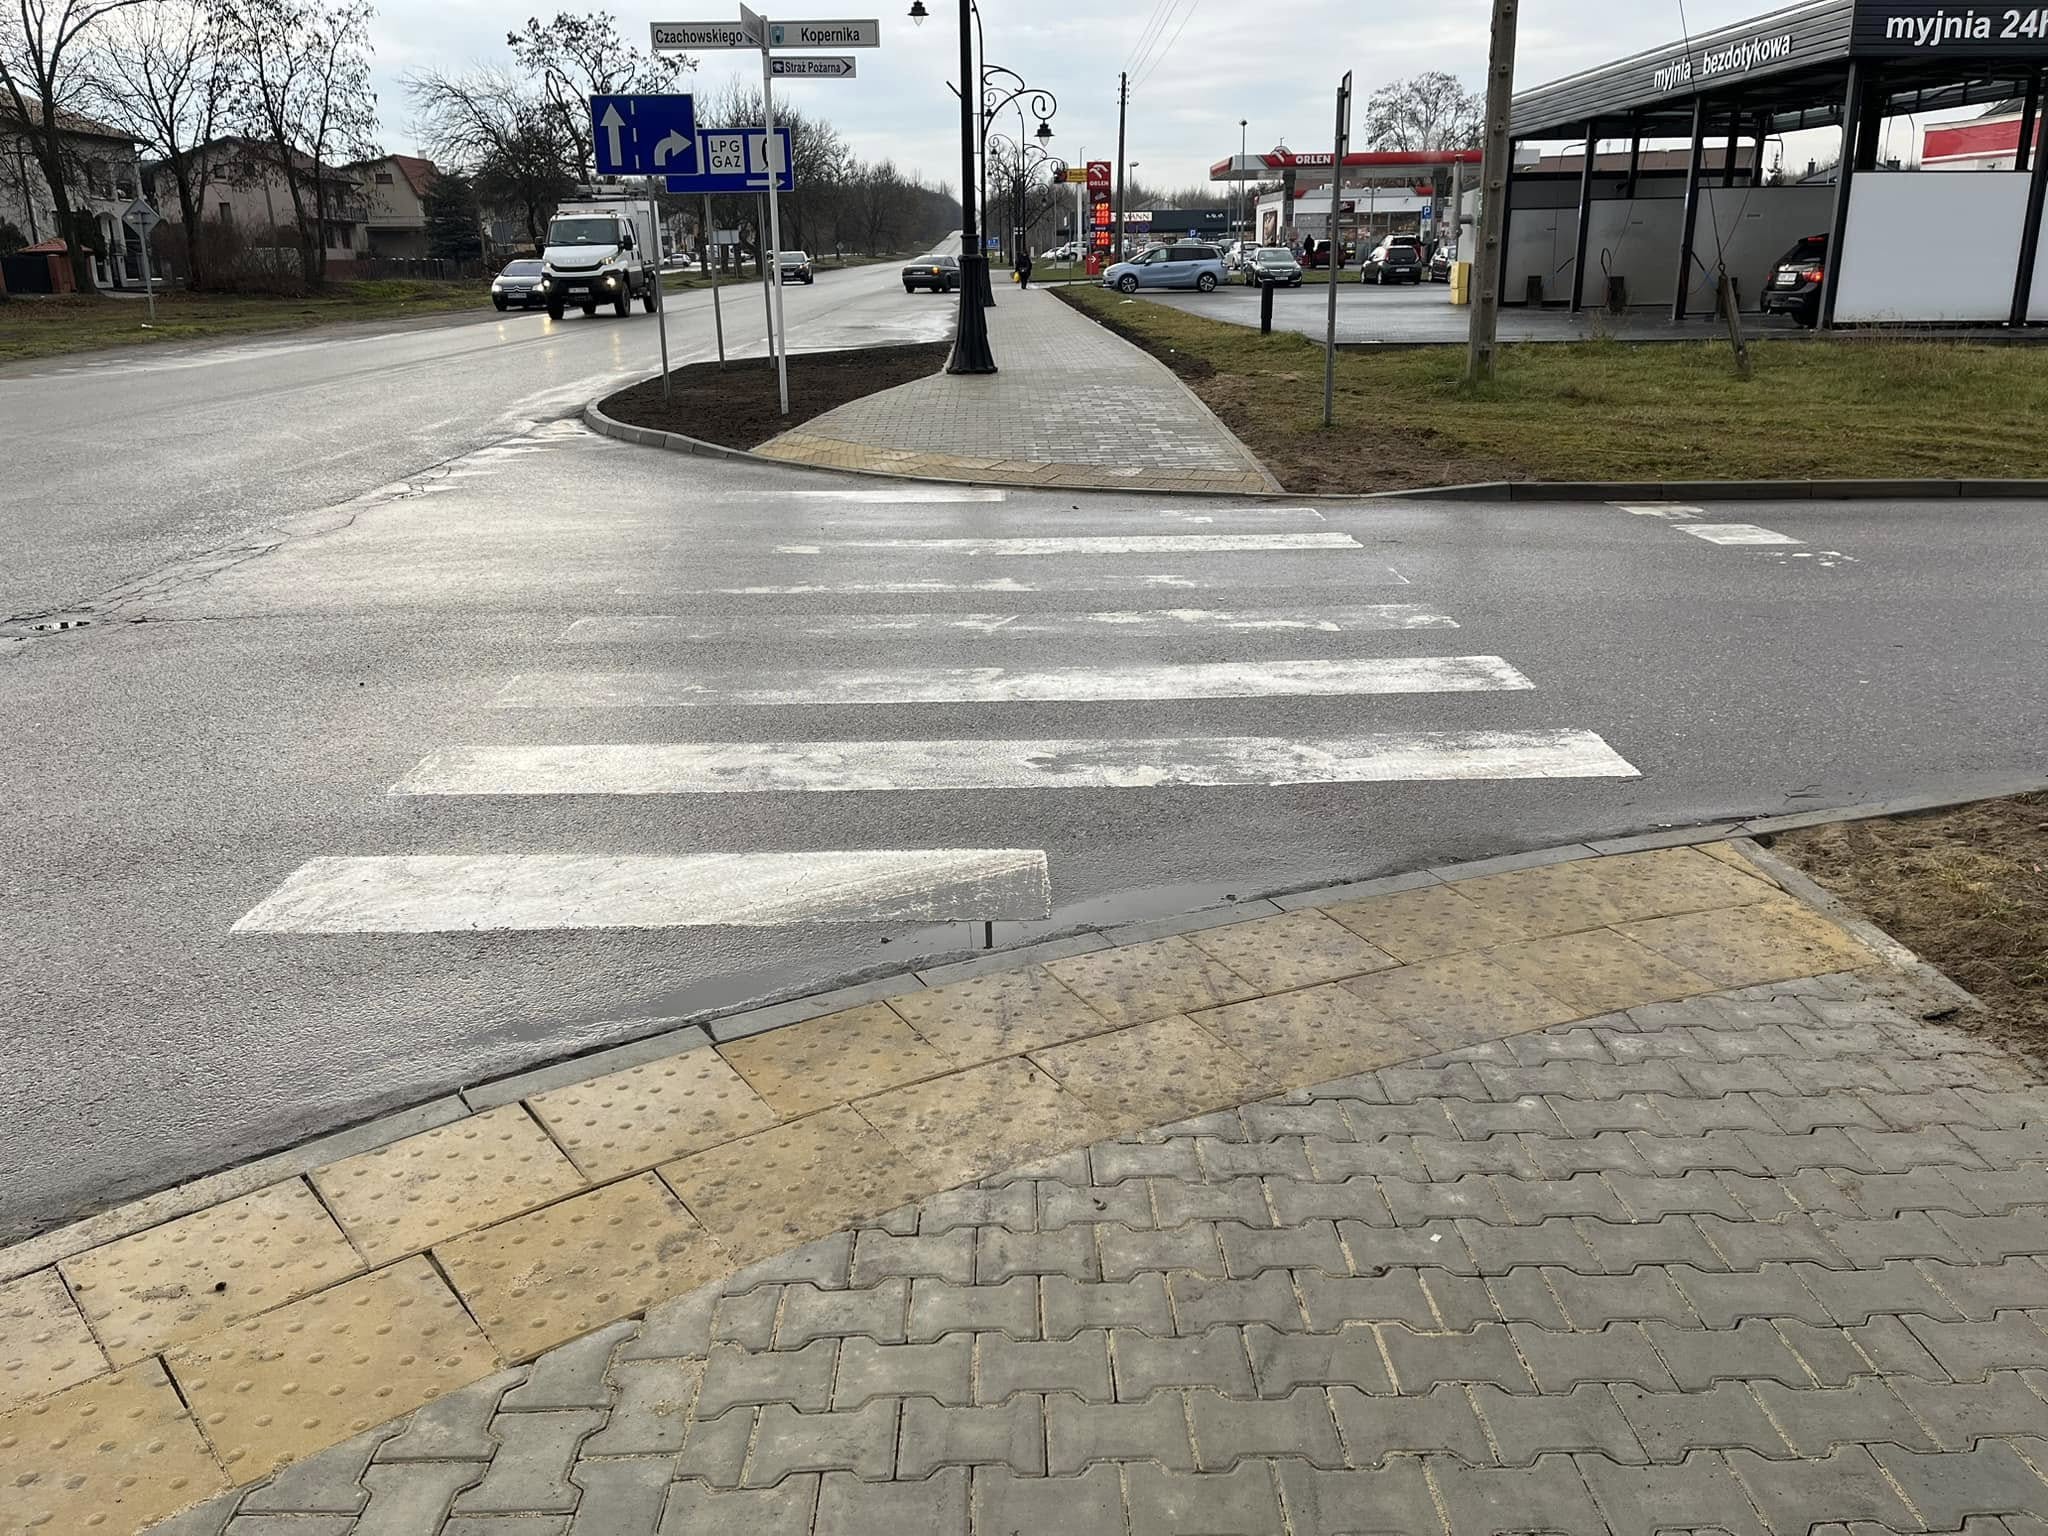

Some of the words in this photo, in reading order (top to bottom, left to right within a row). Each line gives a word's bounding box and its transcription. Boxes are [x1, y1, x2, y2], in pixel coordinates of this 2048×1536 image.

[1886, 10, 1991, 46] myjnia
[655, 29, 743, 46] Czachowskiego
[801, 27, 860, 45] Kopernika
[785, 61, 807, 73] Straż
[808, 61, 841, 73] Pożarna
[1654, 58, 1692, 91] myjnia
[1703, 34, 1792, 76] bezdotykowa
[710, 140, 740, 153] LPG
[711, 155, 742, 168] GAZ
[1295, 155, 1331, 165] ORLEN
